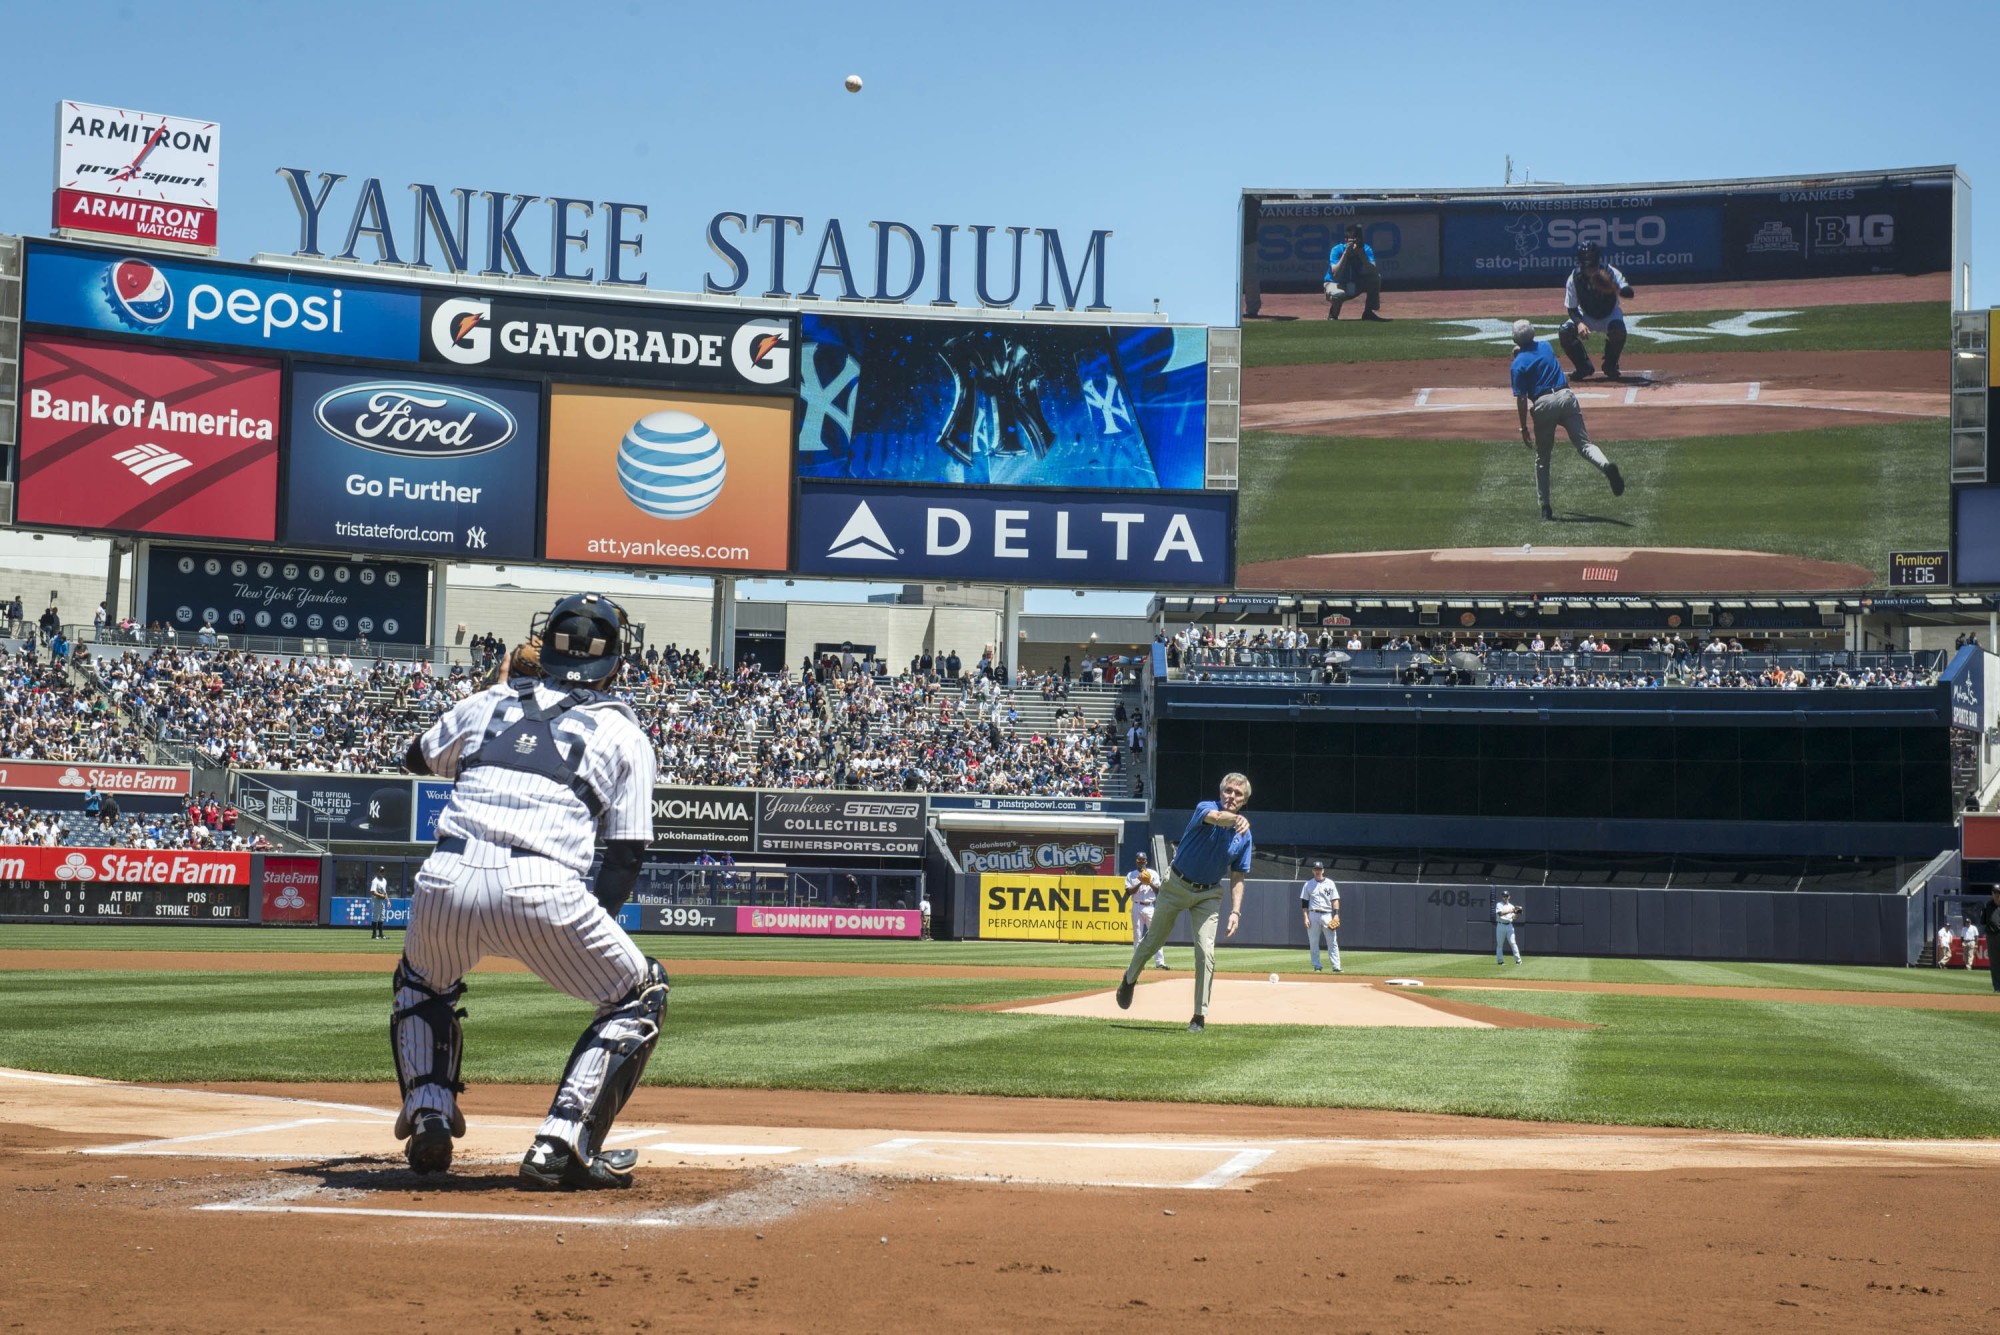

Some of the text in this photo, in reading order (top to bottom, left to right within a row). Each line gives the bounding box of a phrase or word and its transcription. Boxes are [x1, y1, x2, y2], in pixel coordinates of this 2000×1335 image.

[68, 116, 211, 153] ARMITRON
[76, 164, 119, 175] pro
[1502, 198, 1653, 211] YANKEESBEISBOL.COM
[1780, 190, 1855, 202] @YANKEES
[73, 197, 201, 229] ARMITRON
[1258, 206, 1356, 217] YANKEES.COM
[137, 222, 199, 240] WATCHES
[276, 167, 1113, 310] YANKEE STADIUM
[1547, 215, 1667, 248] sato
[1475, 252, 1693, 270] sato-pharmautical.com
[187, 288, 343, 338] pepsi
[431, 297, 790, 384] G GATORADE G
[30, 389, 273, 441] Bank of America
[355, 391, 477, 446] Ford
[346, 474, 482, 504] Go Further
[335, 520, 454, 543] tristateford.com
[926, 507, 1203, 562] DELTA
[587, 538, 749, 560] att.yankees.com
[1896, 554, 1941, 566] Armitron
[183, 561, 397, 583] 4 3 5 7 37 8 8 16 15
[1902, 567, 1935, 583] 1:06
[233, 583, 348, 608] New York Yankees
[179, 609, 190, 618] 32
[208, 612, 214, 620] 9
[283, 616, 295, 625] 44
[309, 618, 320, 626] 23
[335, 619, 346, 628] 49
[360, 621, 371, 629] 42
[388, 622, 394, 631] 6
[567, 671, 581, 680] 66
[311, 798, 351, 808] ON-FIELD
[325, 791, 350, 799] OFFICIAL
[652, 800, 748, 820] KOHAMA
[764, 794, 831, 821] Yankees
[845, 803, 917, 816] STEINER
[997, 800, 1076, 809] pinstripebowl.com
[784, 819, 897, 833] COLLECTIBLES
[658, 832, 748, 841] yokohamatire.com
[762, 839, 918, 852] STEINERSPORTS.COM
[961, 845, 1034, 873] Peanut
[43, 890, 85, 901] 0 0 0
[110, 891, 122, 901] AT
[125, 891, 143, 902] BAT
[187, 892, 206, 903] POS
[988, 887, 1132, 913] STANLEY
[43, 903, 85, 914] 0 0 0
[98, 903, 122, 915] BALL
[155, 905, 189, 916] STRIKE
[212, 906, 232, 916] OUT
[765, 914, 906, 930] DUNKIN' DONUTS
[988, 918, 1128, 931] PERFORMANCE IN ACTION
